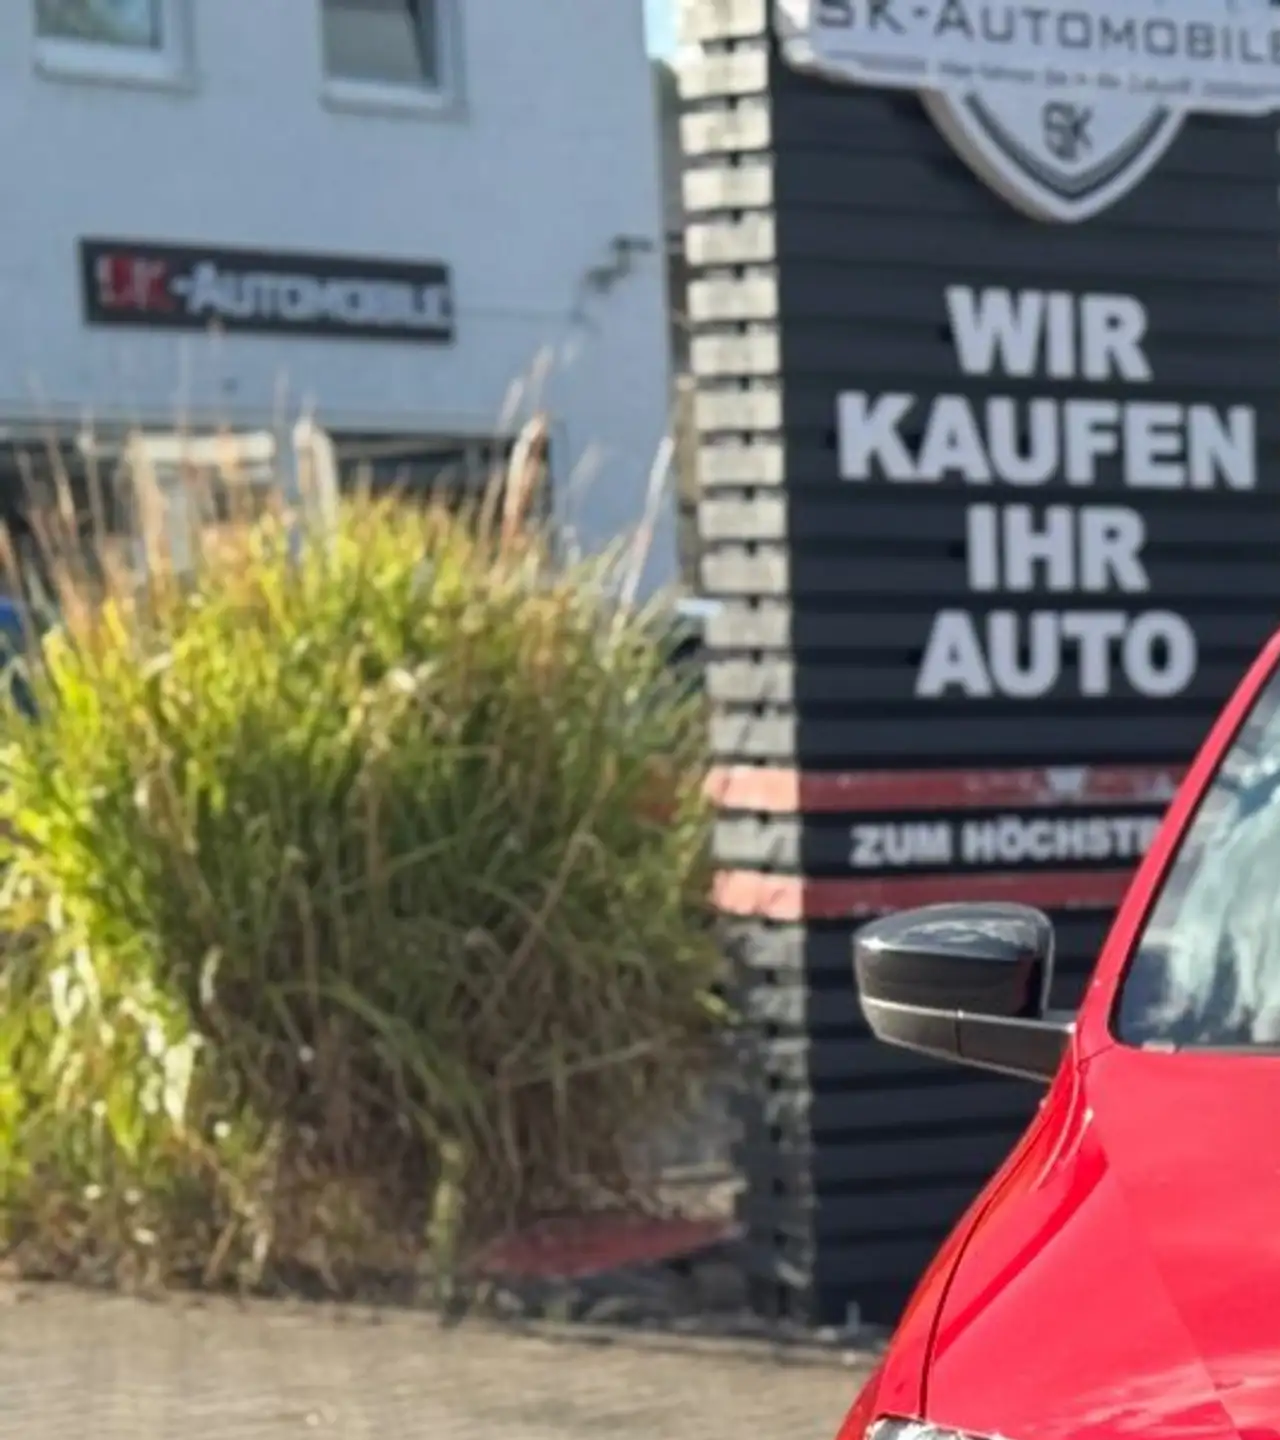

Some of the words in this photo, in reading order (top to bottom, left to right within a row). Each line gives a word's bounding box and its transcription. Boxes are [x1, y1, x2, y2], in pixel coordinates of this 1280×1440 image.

[945, 286, 1152, 381] WIR
[837, 391, 1257, 489] KAUFEN
[967, 505, 1149, 591] IHR
[915, 611, 1196, 697] AUTO
[850, 823, 952, 867] ZUM
